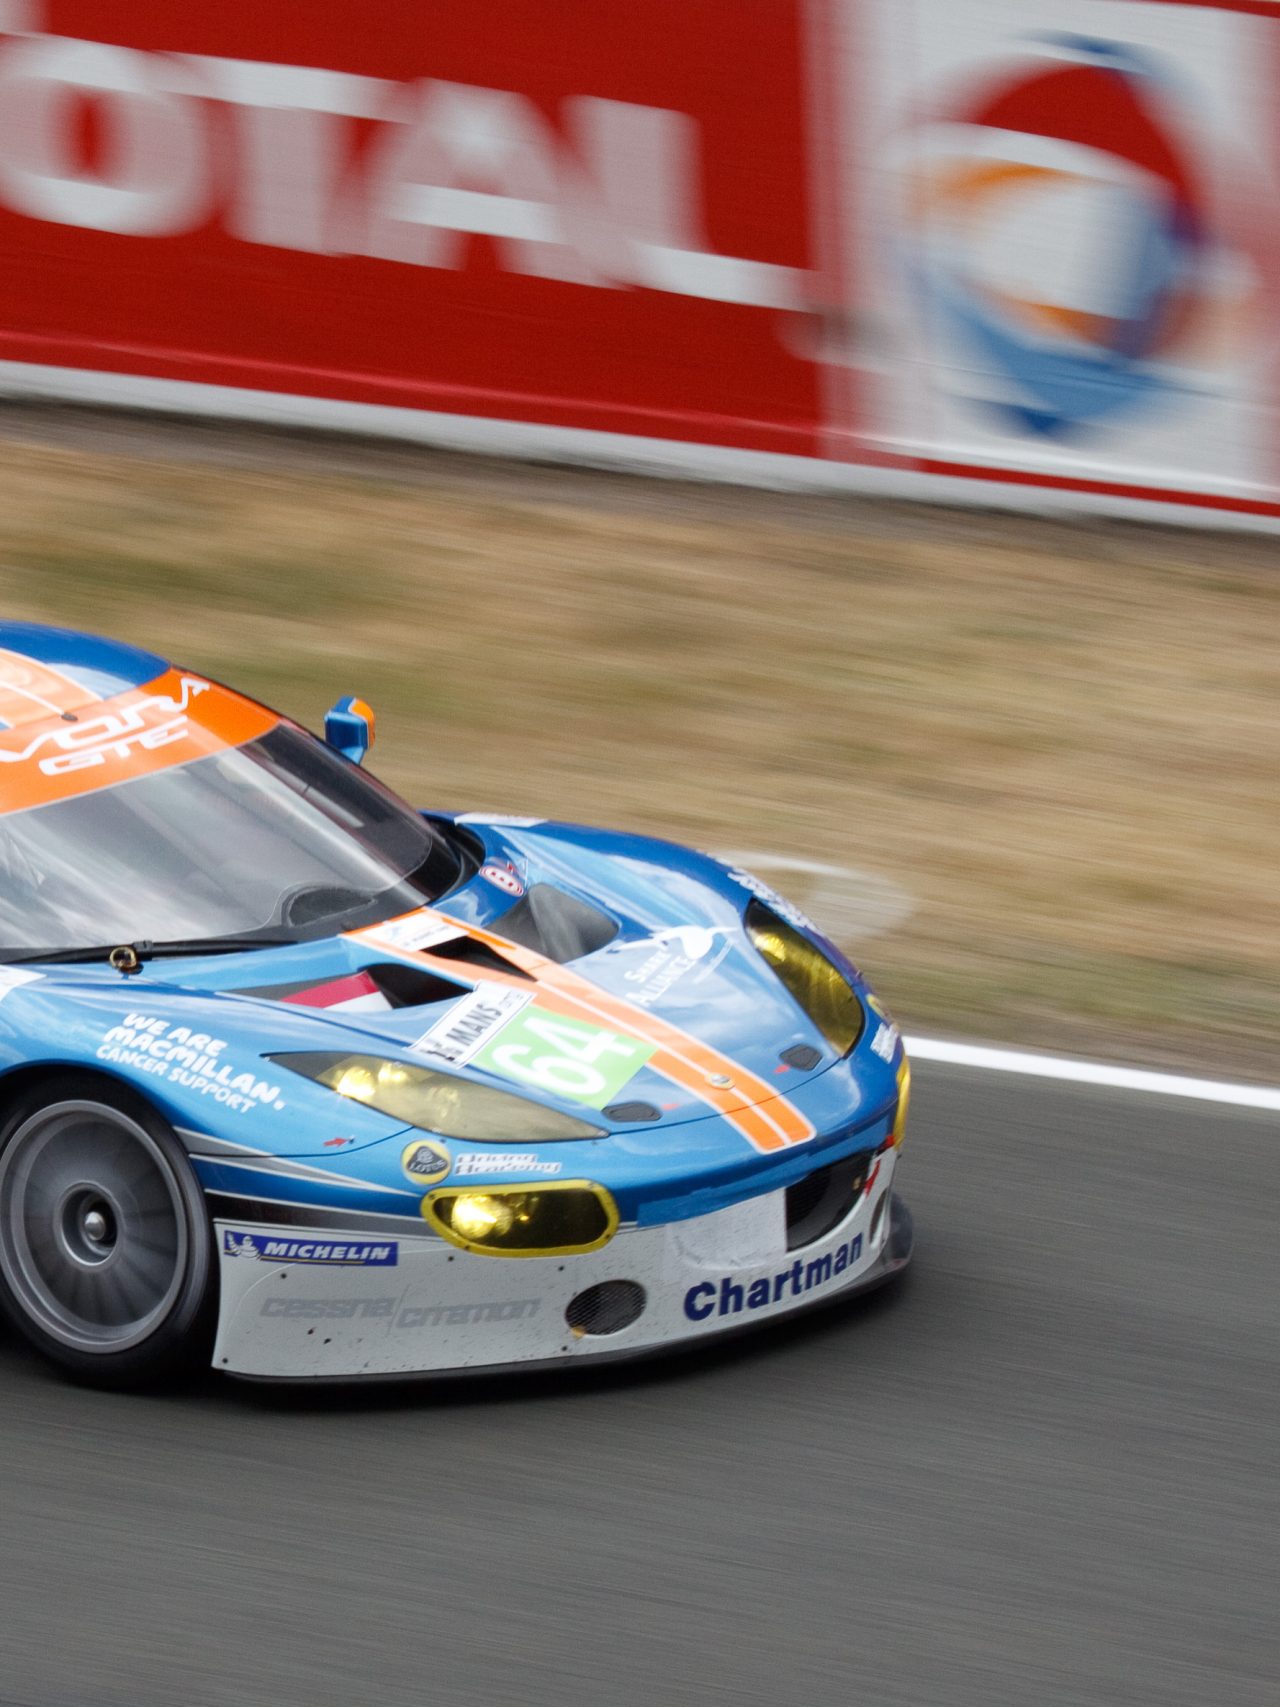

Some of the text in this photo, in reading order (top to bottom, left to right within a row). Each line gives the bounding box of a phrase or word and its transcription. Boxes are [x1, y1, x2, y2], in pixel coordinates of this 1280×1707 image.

[38, 715, 188, 776] GTE
[122, 1013, 228, 1057] WE ARE
[446, 1003, 503, 1047] MANS
[491, 1016, 637, 1095] 64
[96, 1045, 257, 1114] CANCER SUPPORT
[103, 1025, 286, 1111] MACMILLAN.
[408, 1159, 449, 1174] LOTUS
[263, 1241, 391, 1261] MICHELIN
[684, 1232, 864, 1321] Chartman
